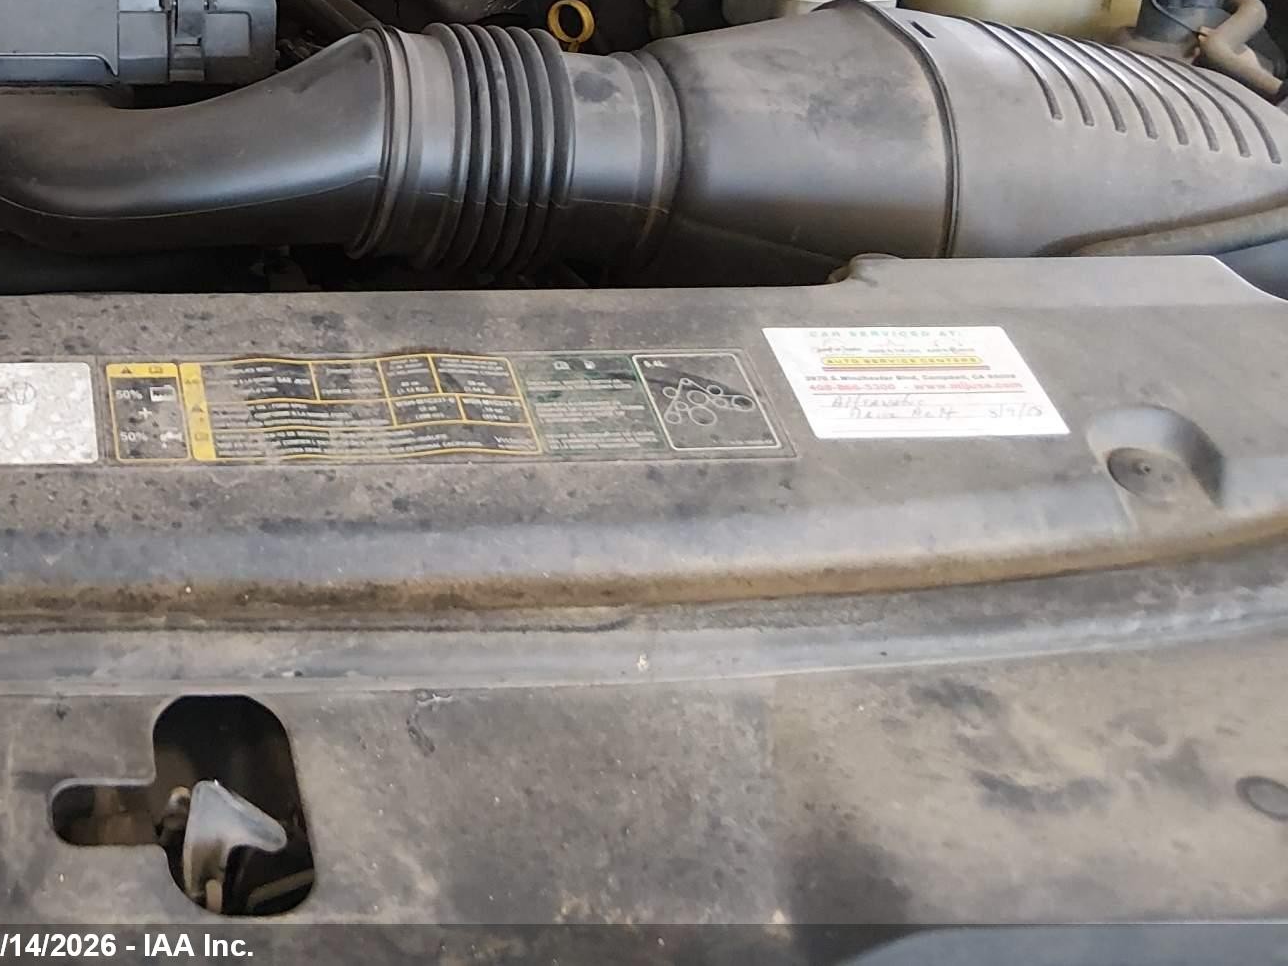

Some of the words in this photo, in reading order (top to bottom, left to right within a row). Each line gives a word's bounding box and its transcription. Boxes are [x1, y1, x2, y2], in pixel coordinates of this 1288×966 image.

[920, 356, 977, 364] CENTERS
[115, 388, 143, 400] 50%
[120, 431, 149, 443] 50%
